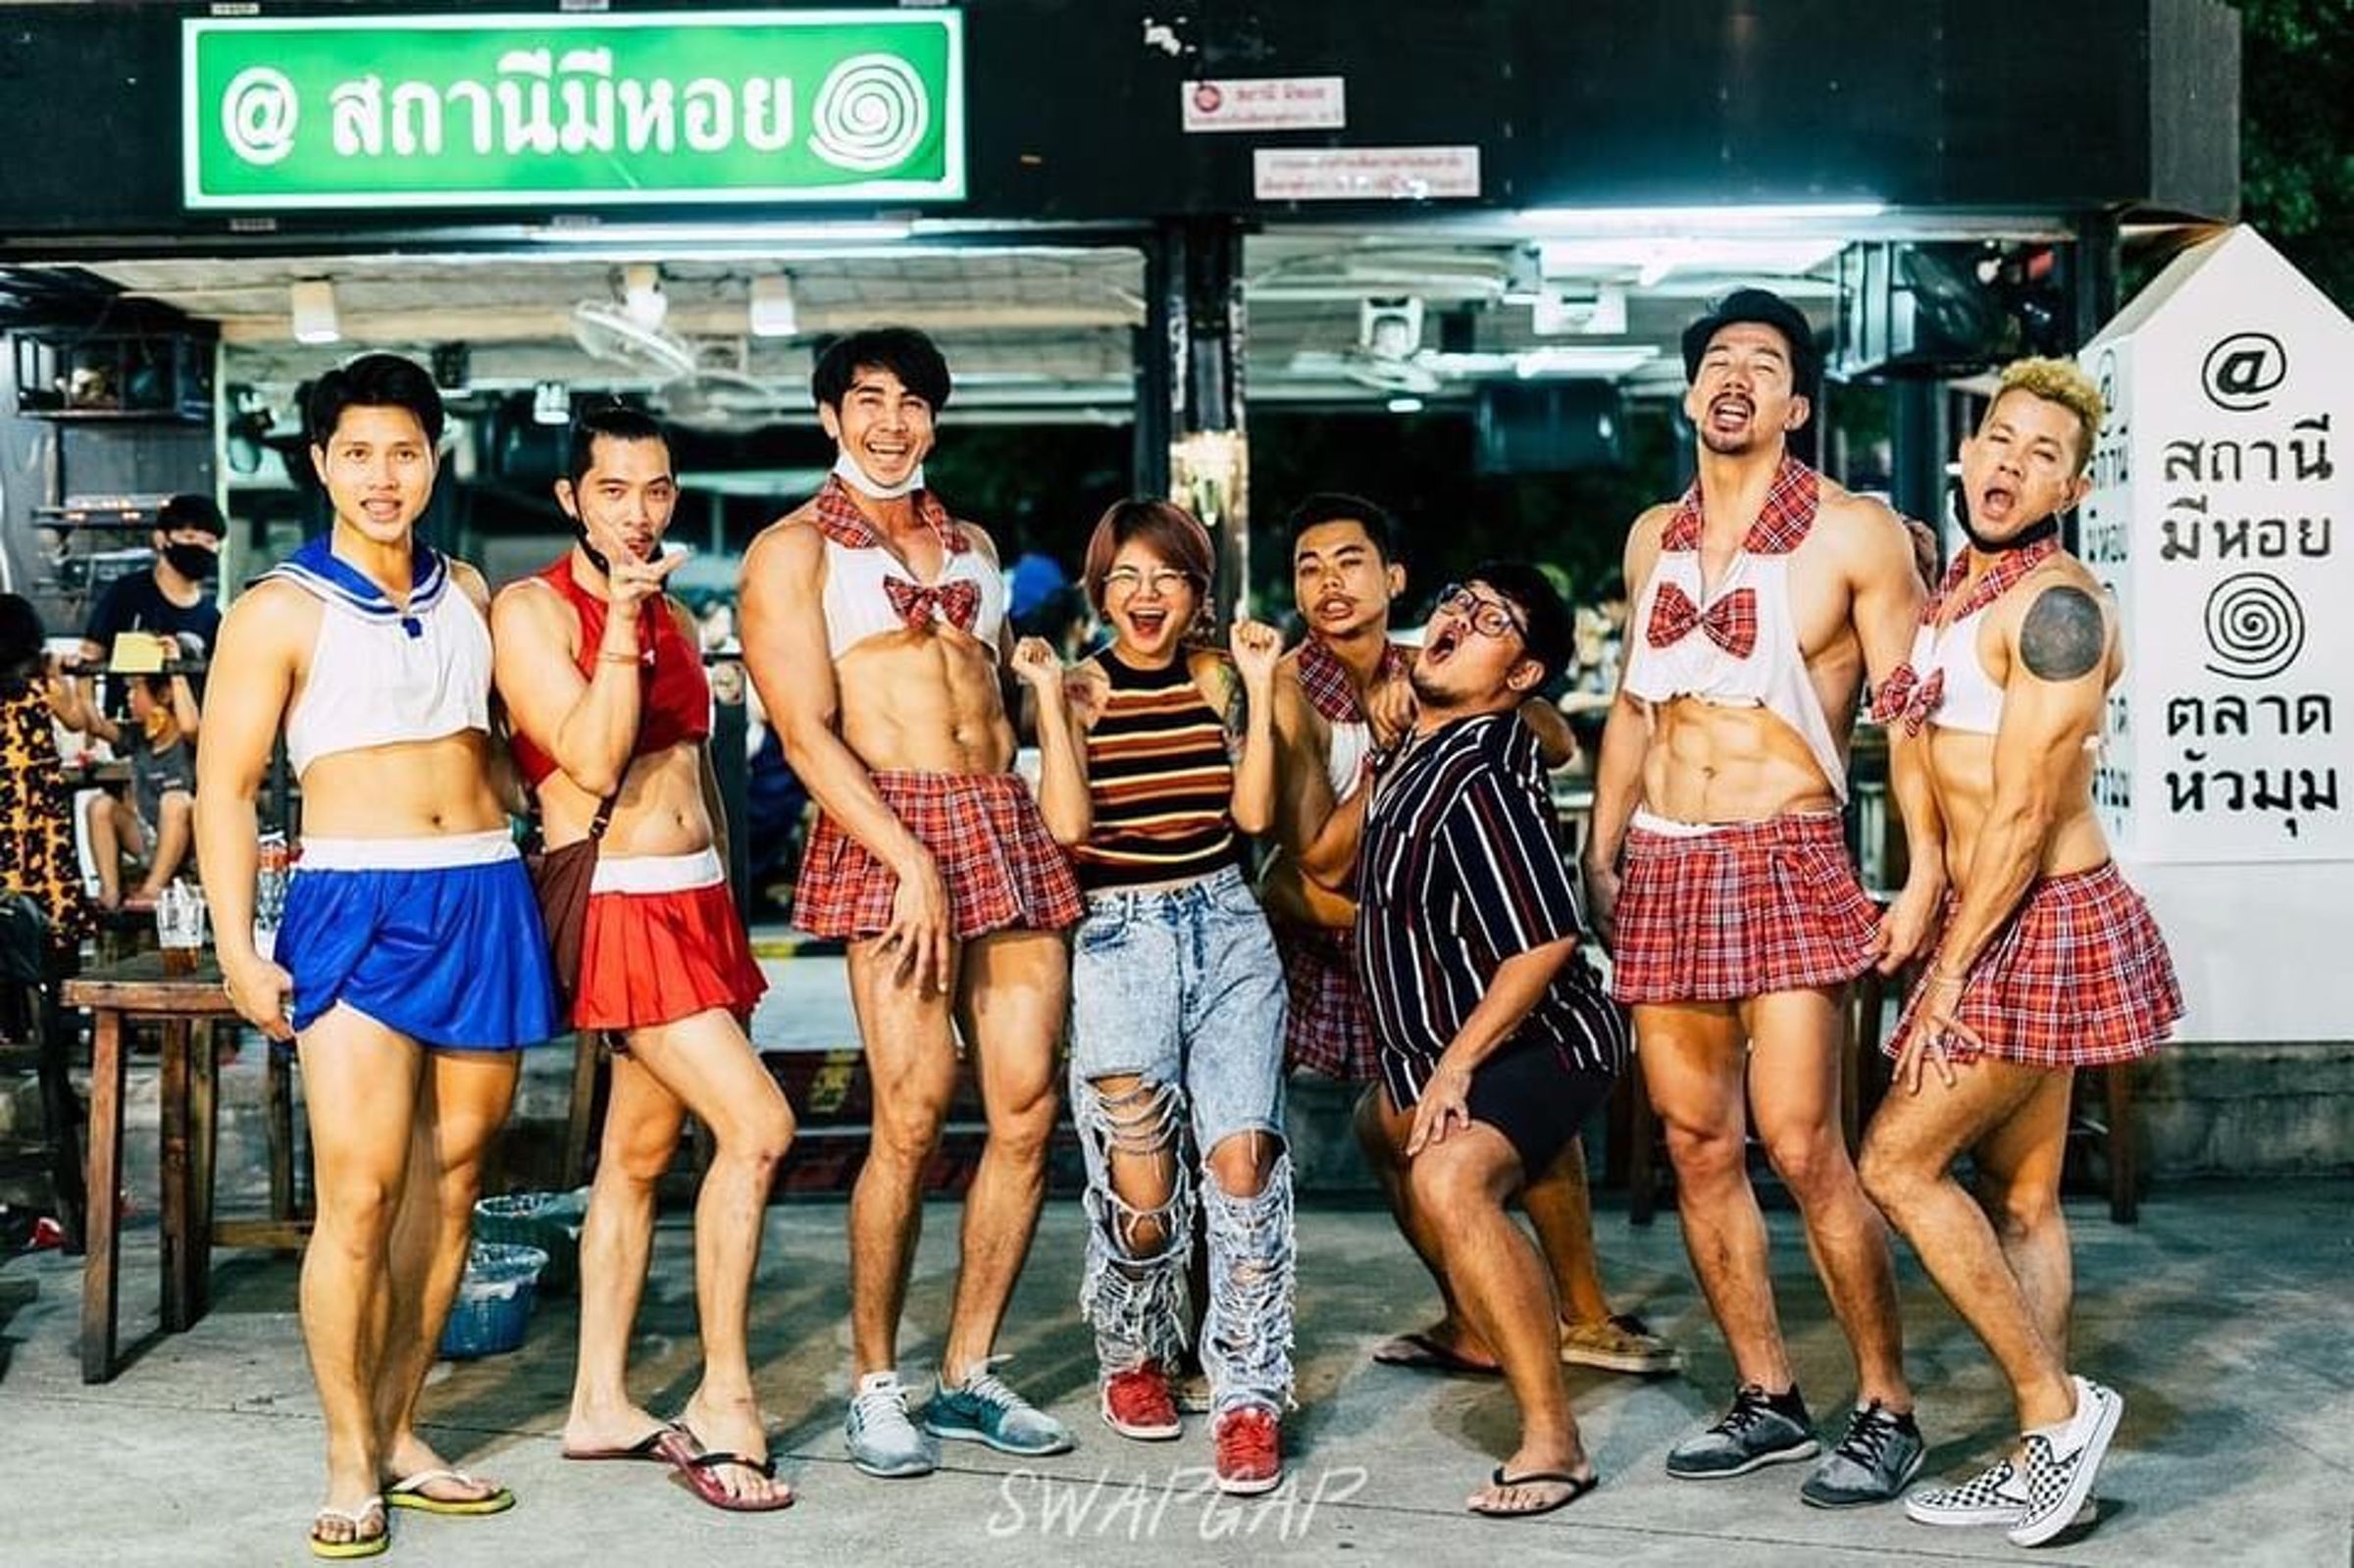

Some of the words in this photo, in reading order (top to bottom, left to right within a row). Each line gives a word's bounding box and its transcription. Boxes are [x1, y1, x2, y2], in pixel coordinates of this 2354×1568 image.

[223, 67, 299, 166] @
[331, 48, 794, 156] สถานีมีหอย
[2201, 331, 2287, 412] @
[2164, 413, 2334, 482] สถานี
[2160, 494, 2331, 561] มีหอย
[2166, 693, 2333, 738] ตลาด
[2165, 748, 2338, 838] หัวมุม
